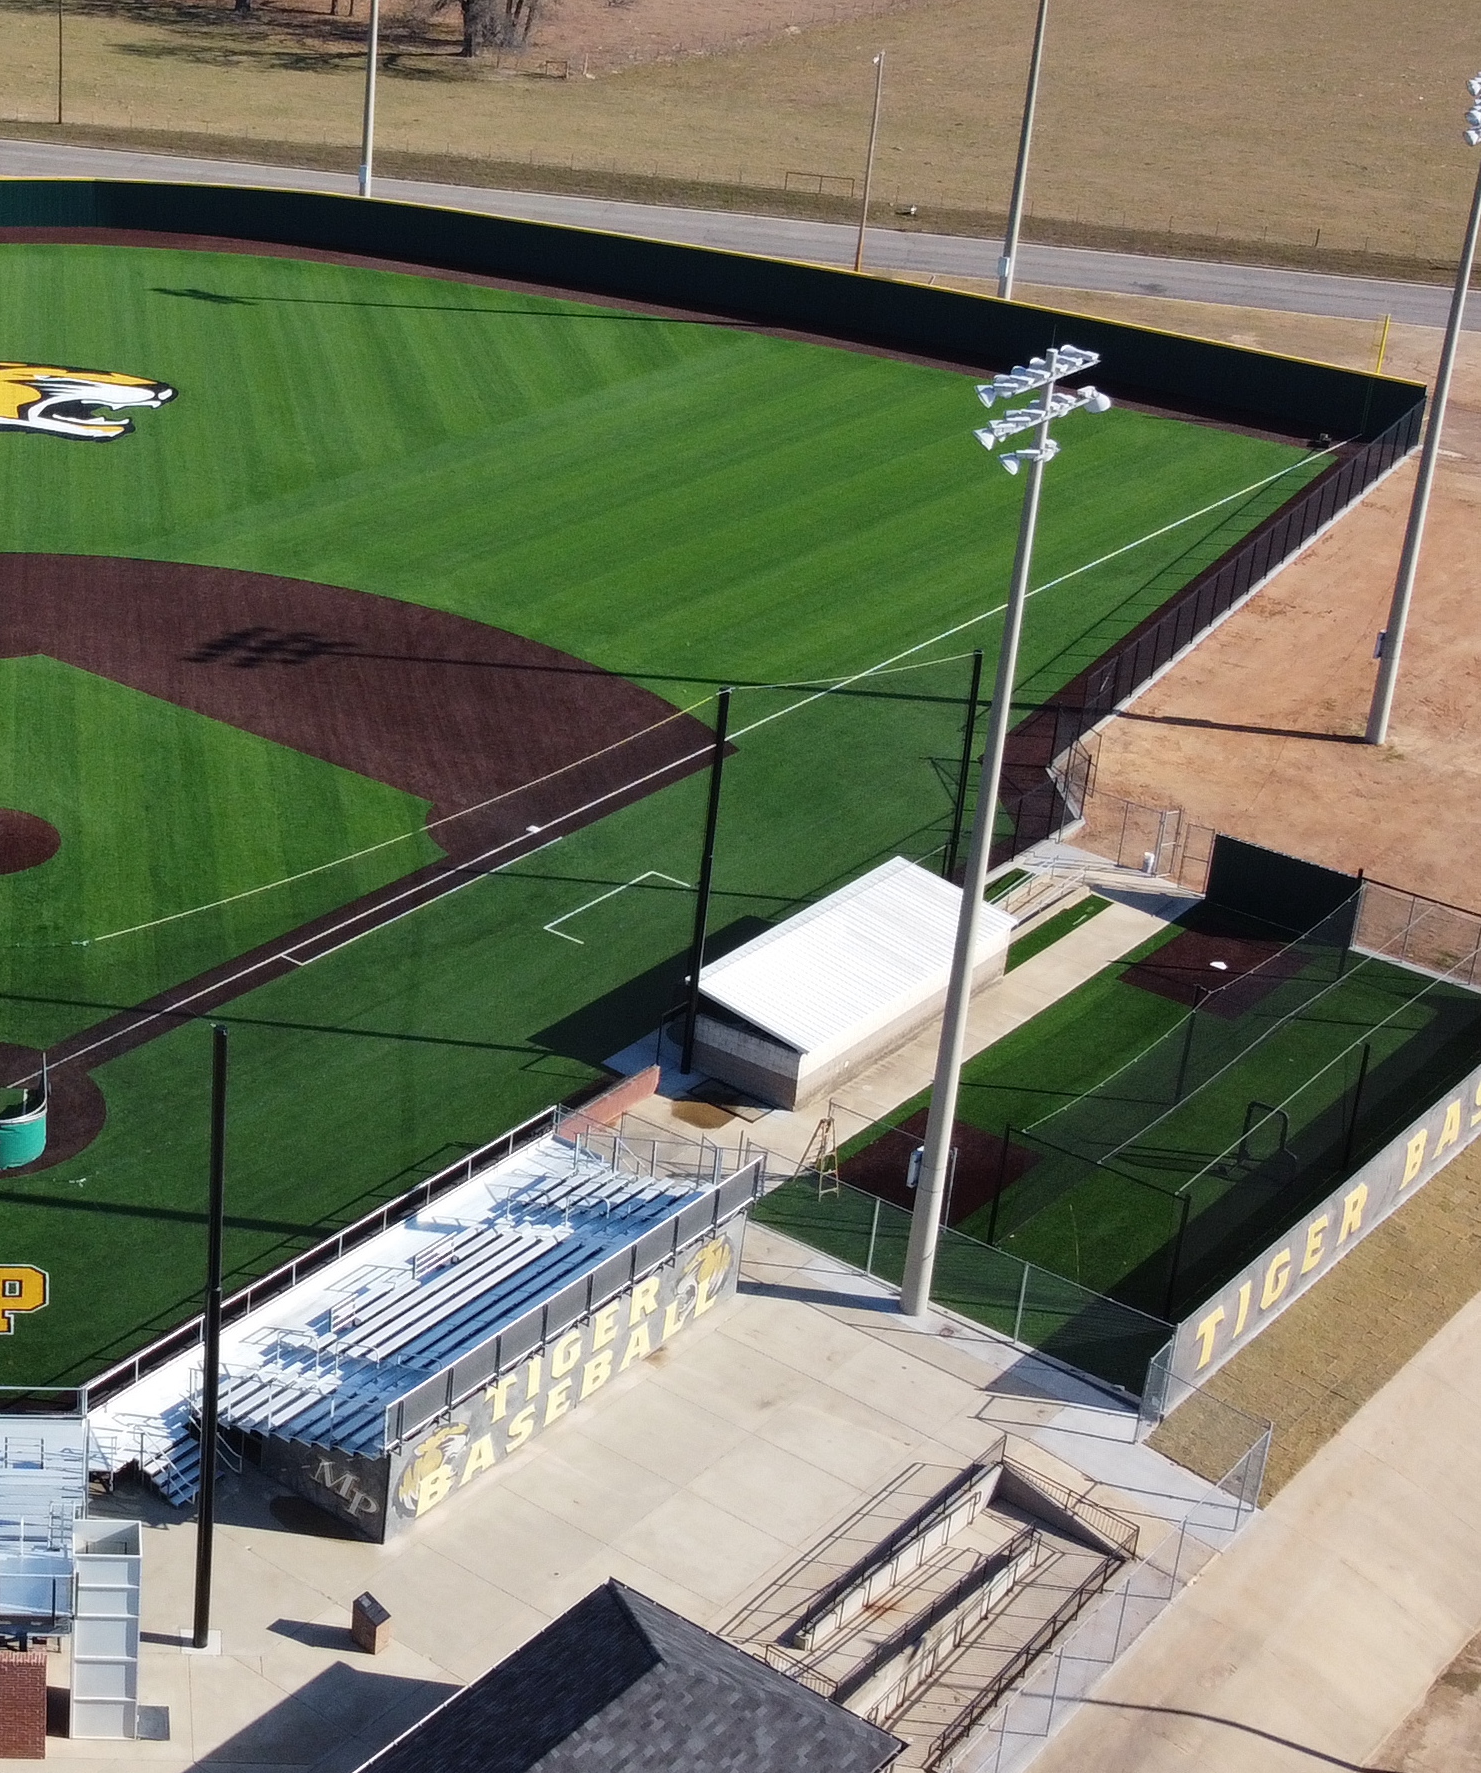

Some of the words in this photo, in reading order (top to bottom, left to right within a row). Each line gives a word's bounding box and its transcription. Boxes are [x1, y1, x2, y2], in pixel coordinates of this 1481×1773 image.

[484, 1275, 661, 1425] TIGER
[1195, 1181, 1369, 1371] TIGER
[414, 1274, 718, 1519] BASEBALL
[309, 1458, 379, 1520] MP
